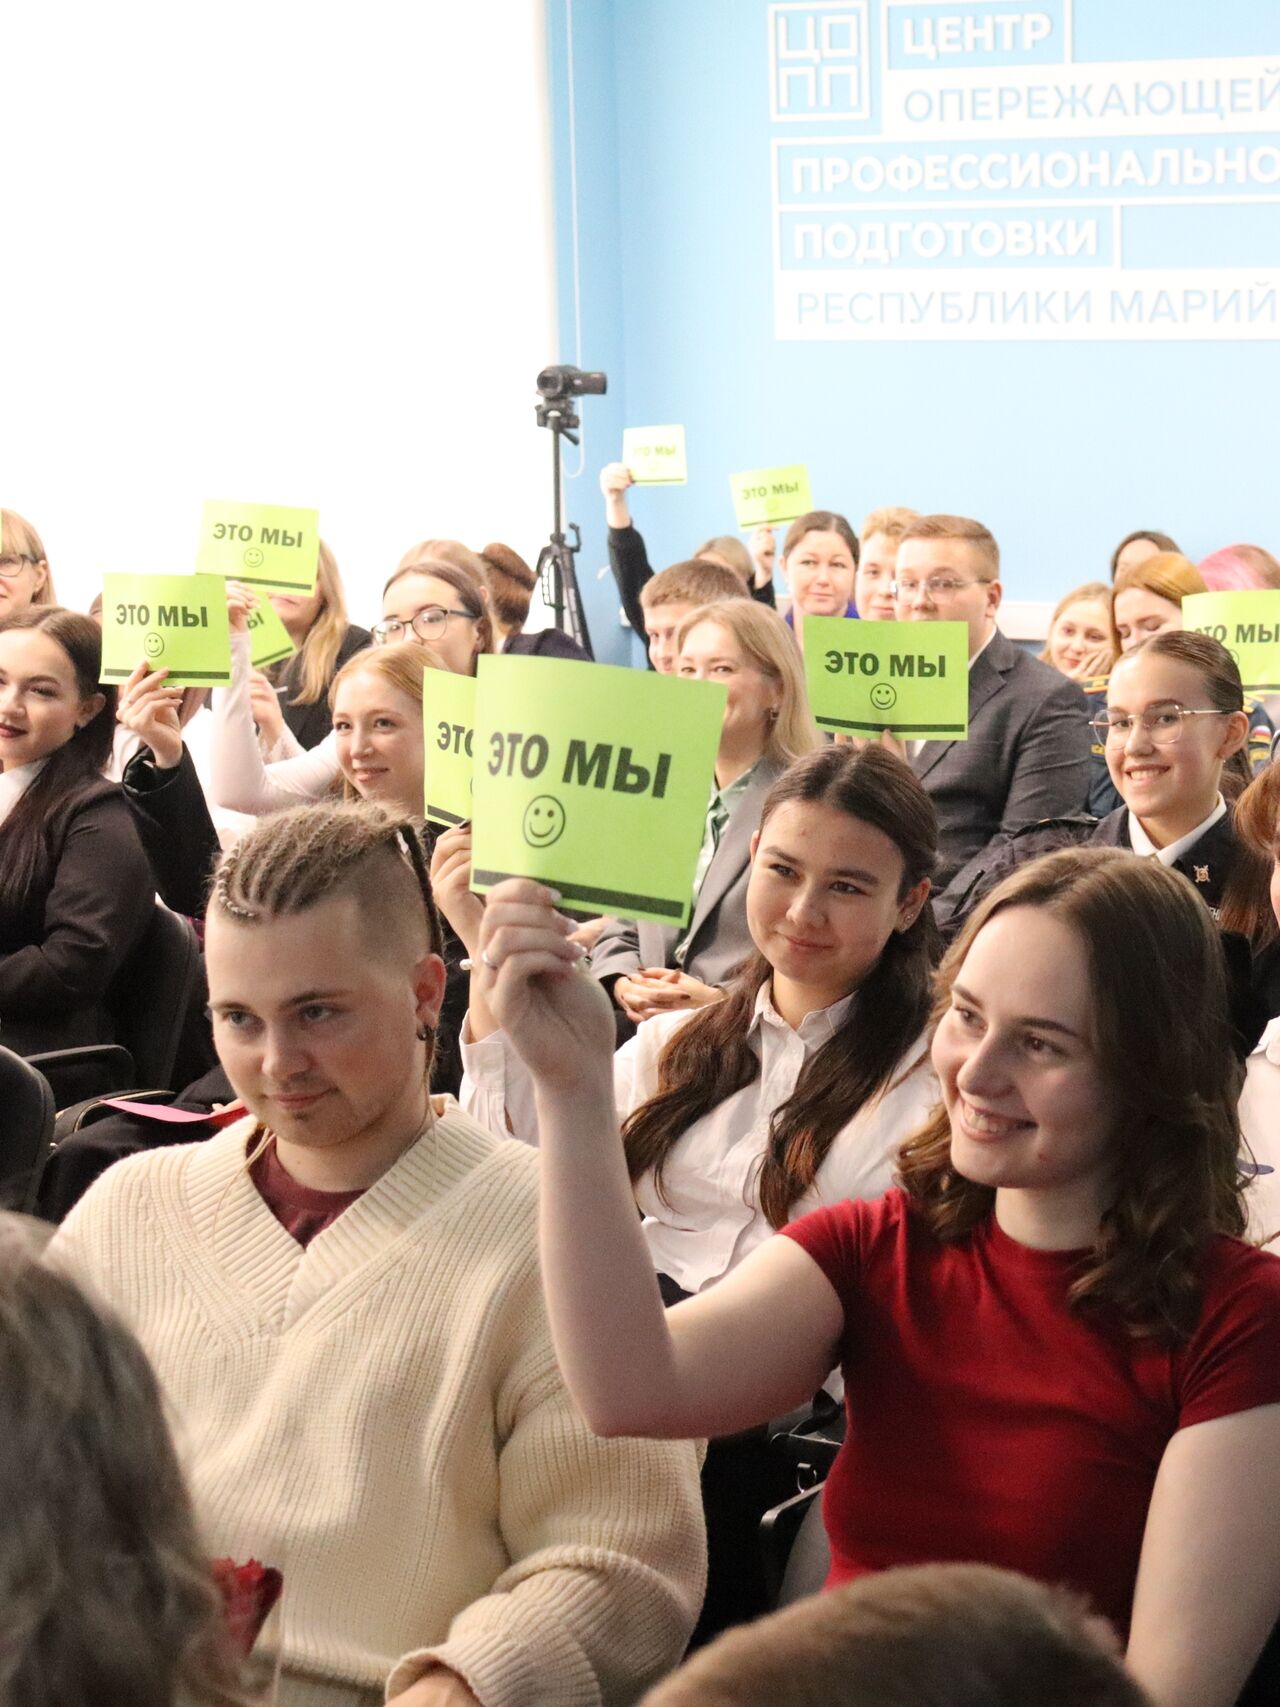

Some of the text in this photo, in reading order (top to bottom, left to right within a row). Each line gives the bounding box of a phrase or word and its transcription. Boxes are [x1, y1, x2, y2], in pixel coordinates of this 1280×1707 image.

[903, 13, 1053, 61] ЦЕНТР
[793, 217, 1098, 264] ПОДГОТОВКИ
[797, 290, 1094, 325] РЕСПУБЛИКИ
[1109, 281, 1278, 325] МАРИЙ
[655, 445, 676, 457] МЫ
[743, 482, 799, 500] ЭТО МЫ
[213, 523, 303, 548] ЭТО МЫ
[116, 604, 209, 628] ЭТО МЫ
[1235, 623, 1280, 643] МЫ
[824, 649, 947, 678] ЭТО МЫ
[487, 731, 672, 799] ЭТО МЫ
